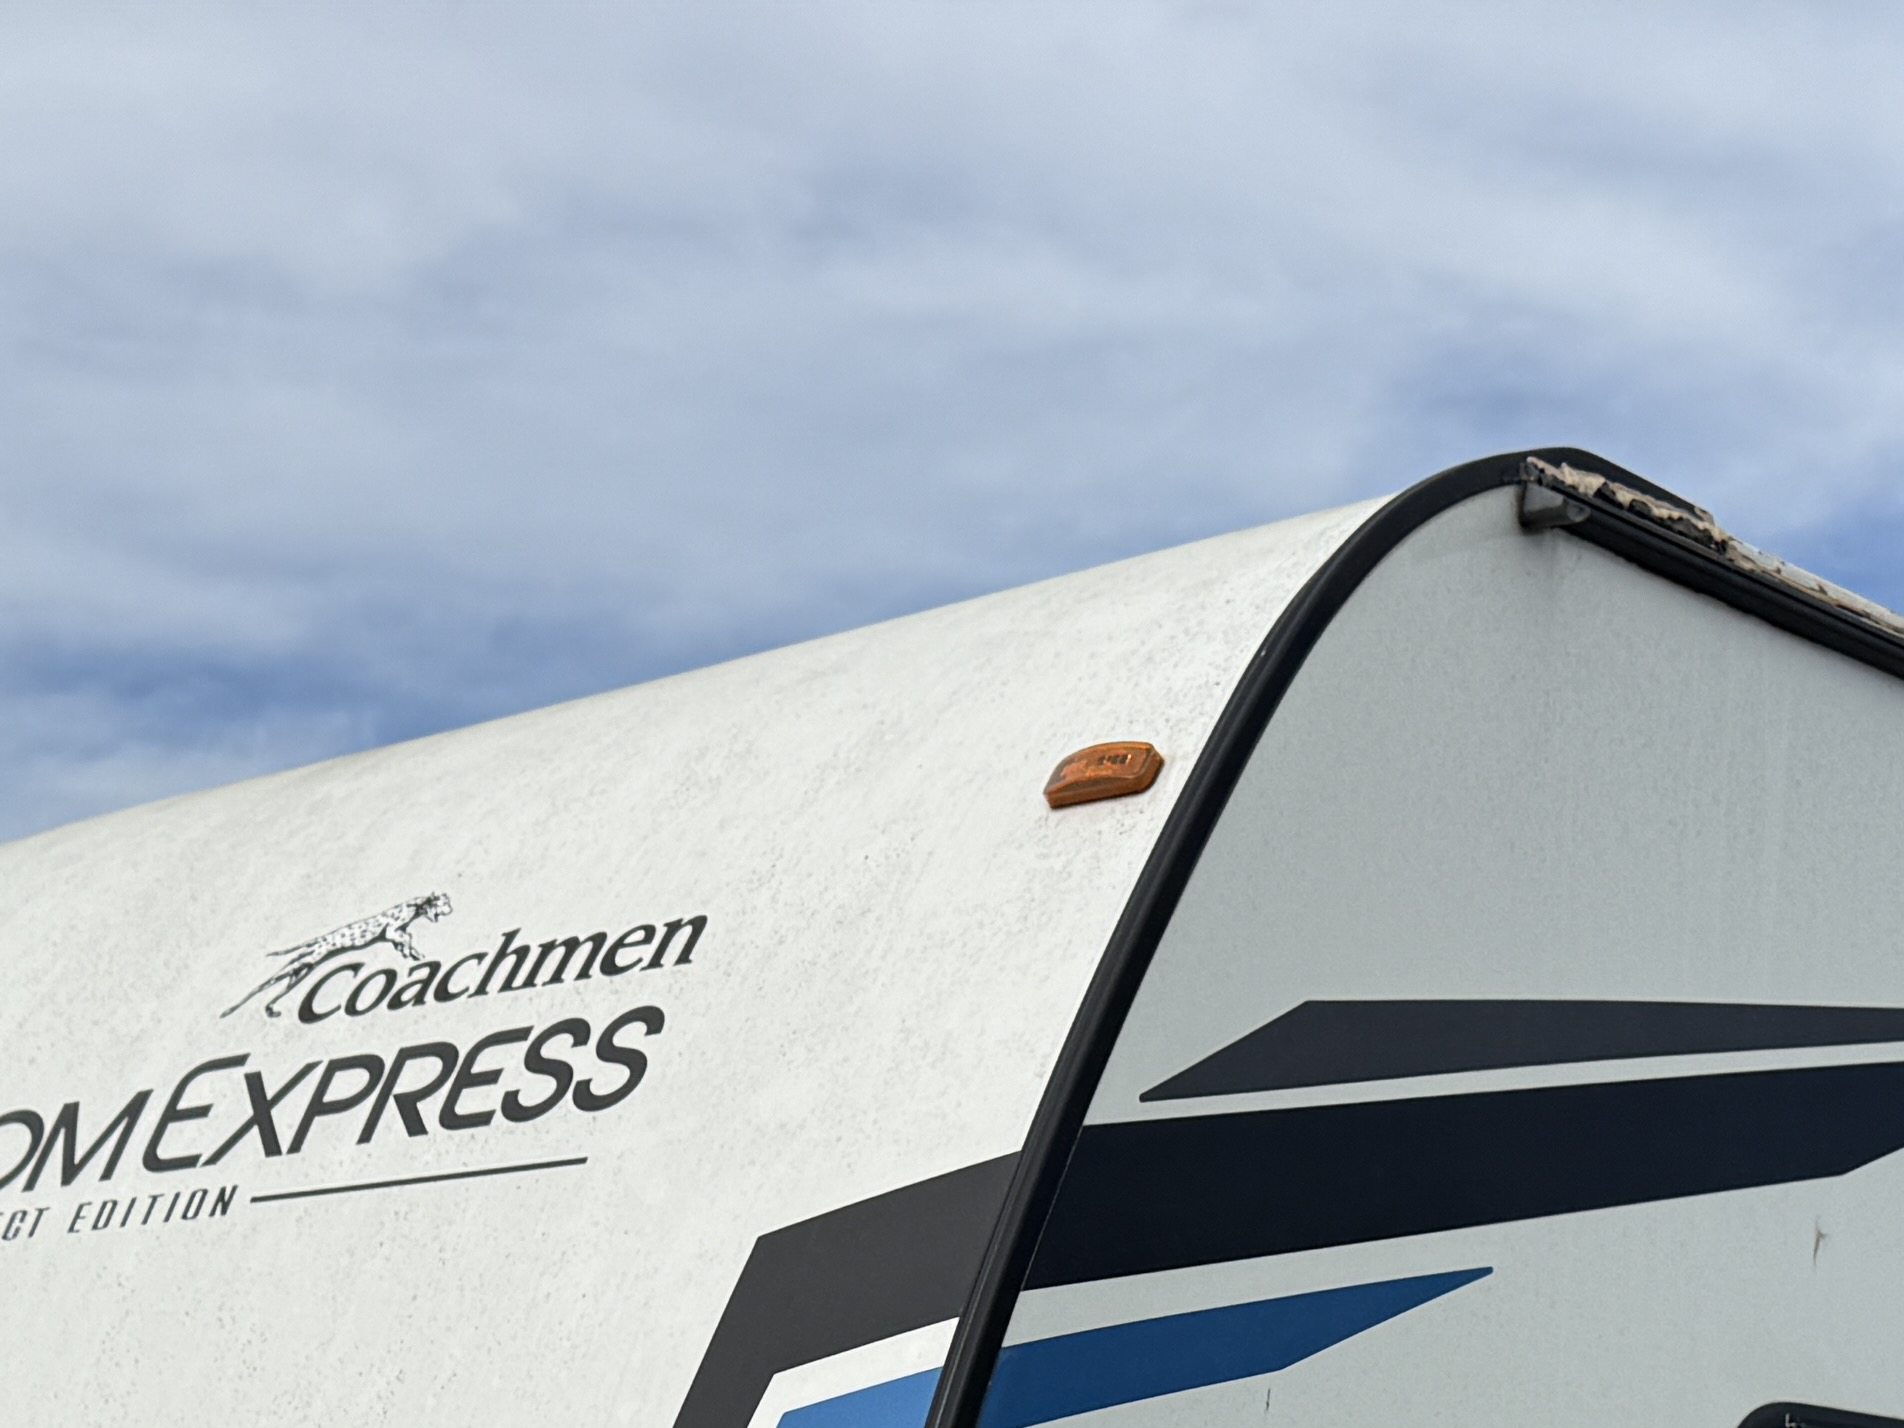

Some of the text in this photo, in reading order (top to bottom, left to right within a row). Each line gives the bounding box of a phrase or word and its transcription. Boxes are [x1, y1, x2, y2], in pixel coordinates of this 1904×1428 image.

[298, 915, 708, 1024] Coachmen
[142, 1005, 665, 1173] EXPRESS
[67, 1185, 238, 1233] EDITION
